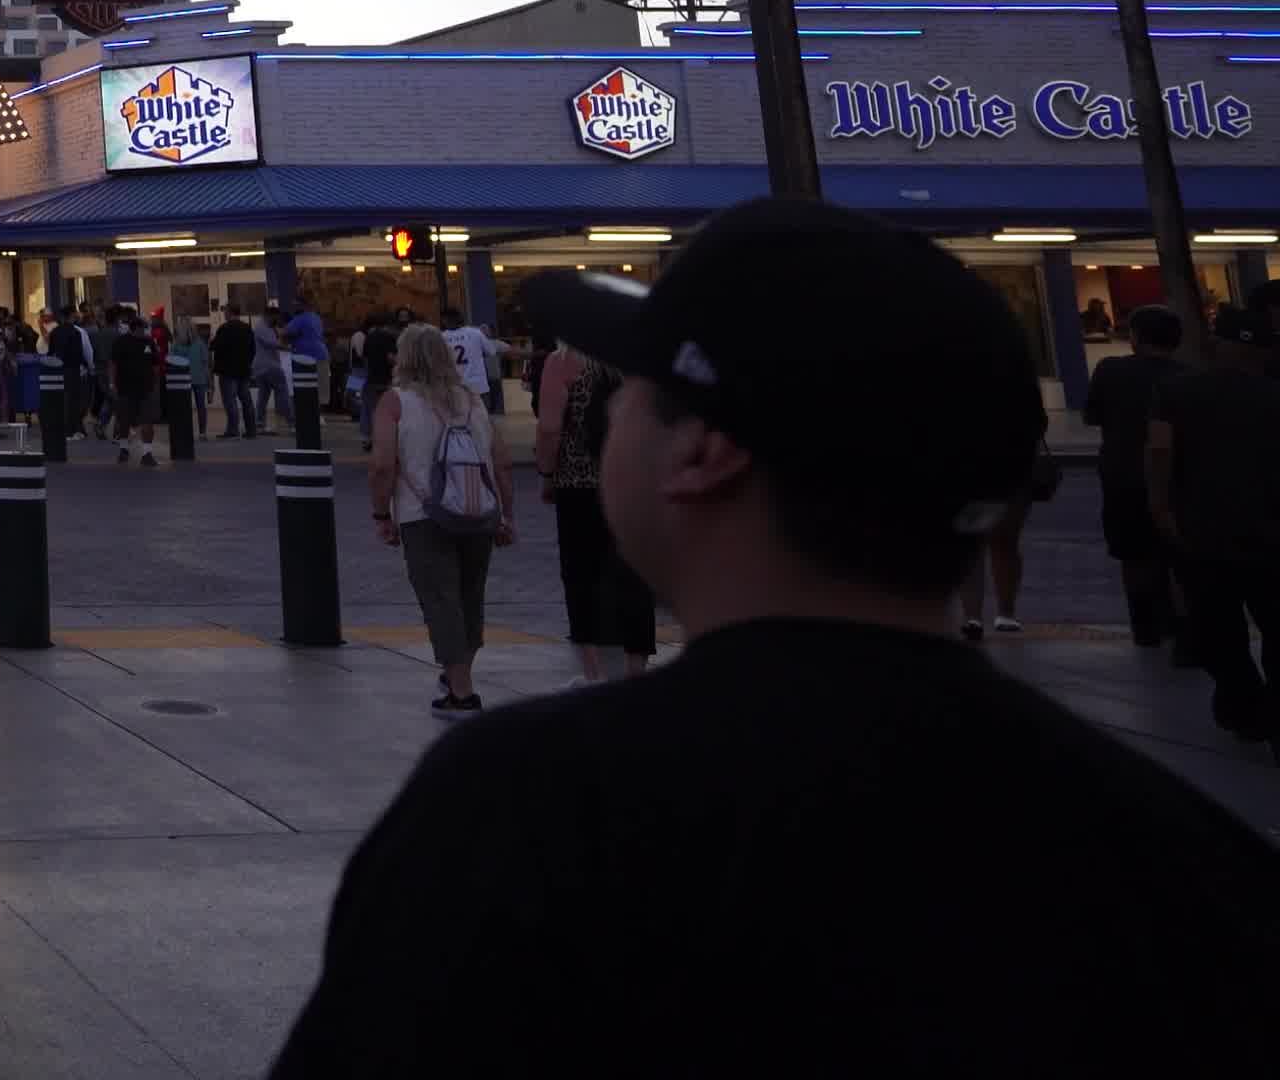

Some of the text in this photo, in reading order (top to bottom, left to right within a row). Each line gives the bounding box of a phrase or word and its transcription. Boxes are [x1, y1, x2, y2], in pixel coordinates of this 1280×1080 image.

[135, 91, 221, 126] White
[590, 93, 662, 121] White
[826, 75, 1252, 149] White Catle
[131, 120, 227, 150] Castle
[587, 119, 668, 141] Castle
